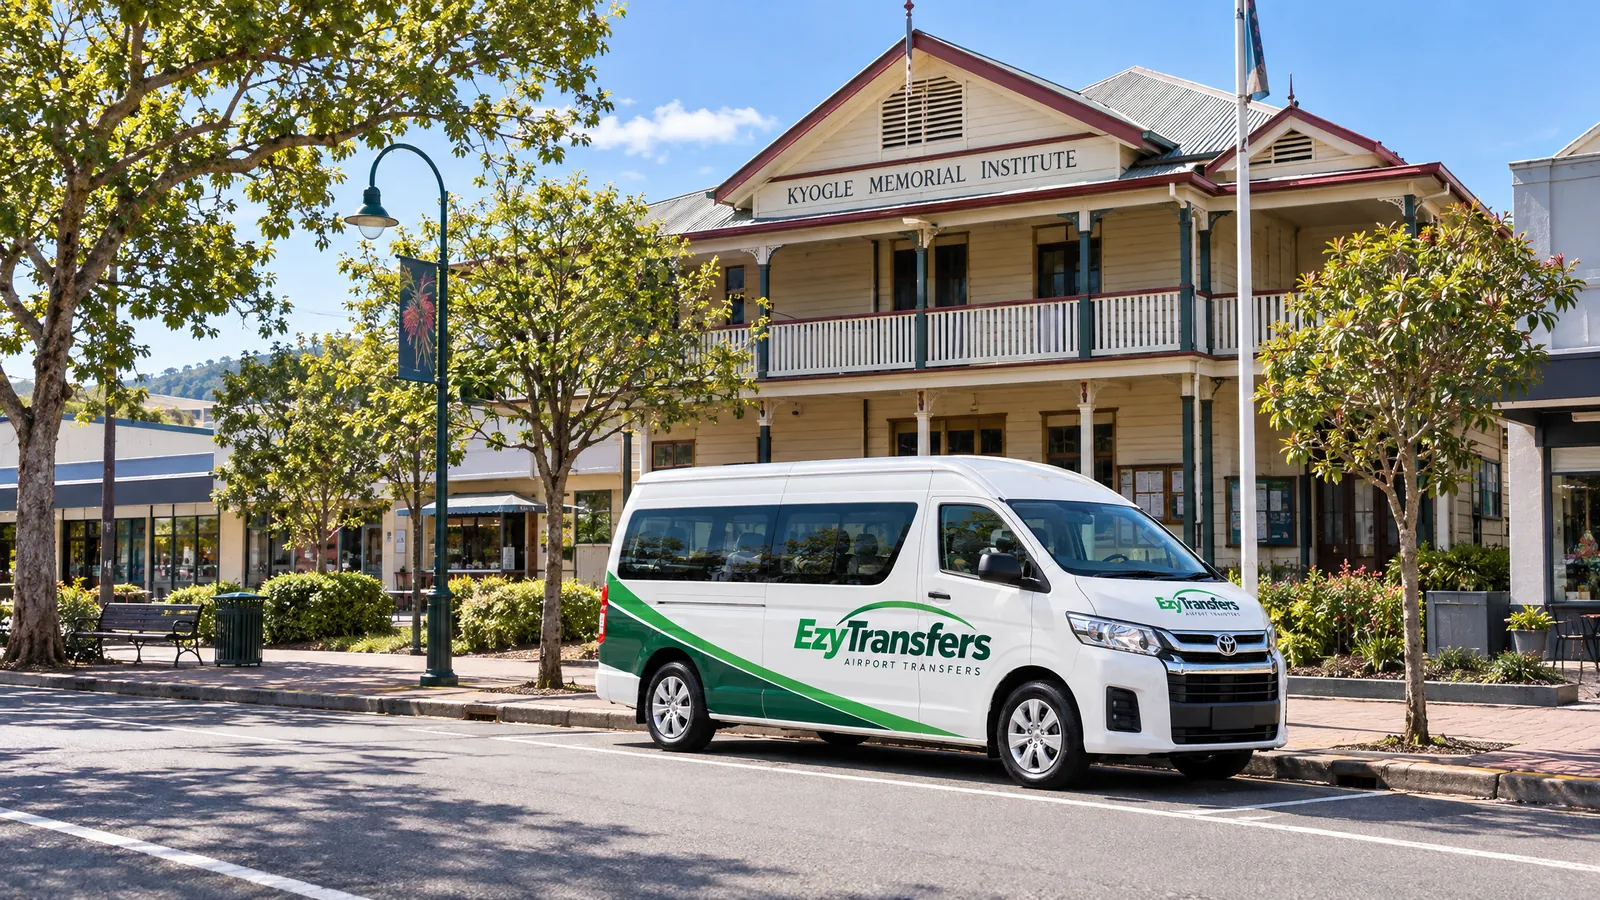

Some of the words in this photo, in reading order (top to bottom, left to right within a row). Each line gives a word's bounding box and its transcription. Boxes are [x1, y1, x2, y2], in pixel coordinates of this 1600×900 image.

[787, 180, 854, 204] KYOGLE
[868, 165, 966, 194] MEMORIAL
[980, 149, 1077, 179] INSTITUTE
[844, 658, 896, 669] AIRPORT
[903, 661, 981, 676] TRANSFERS
